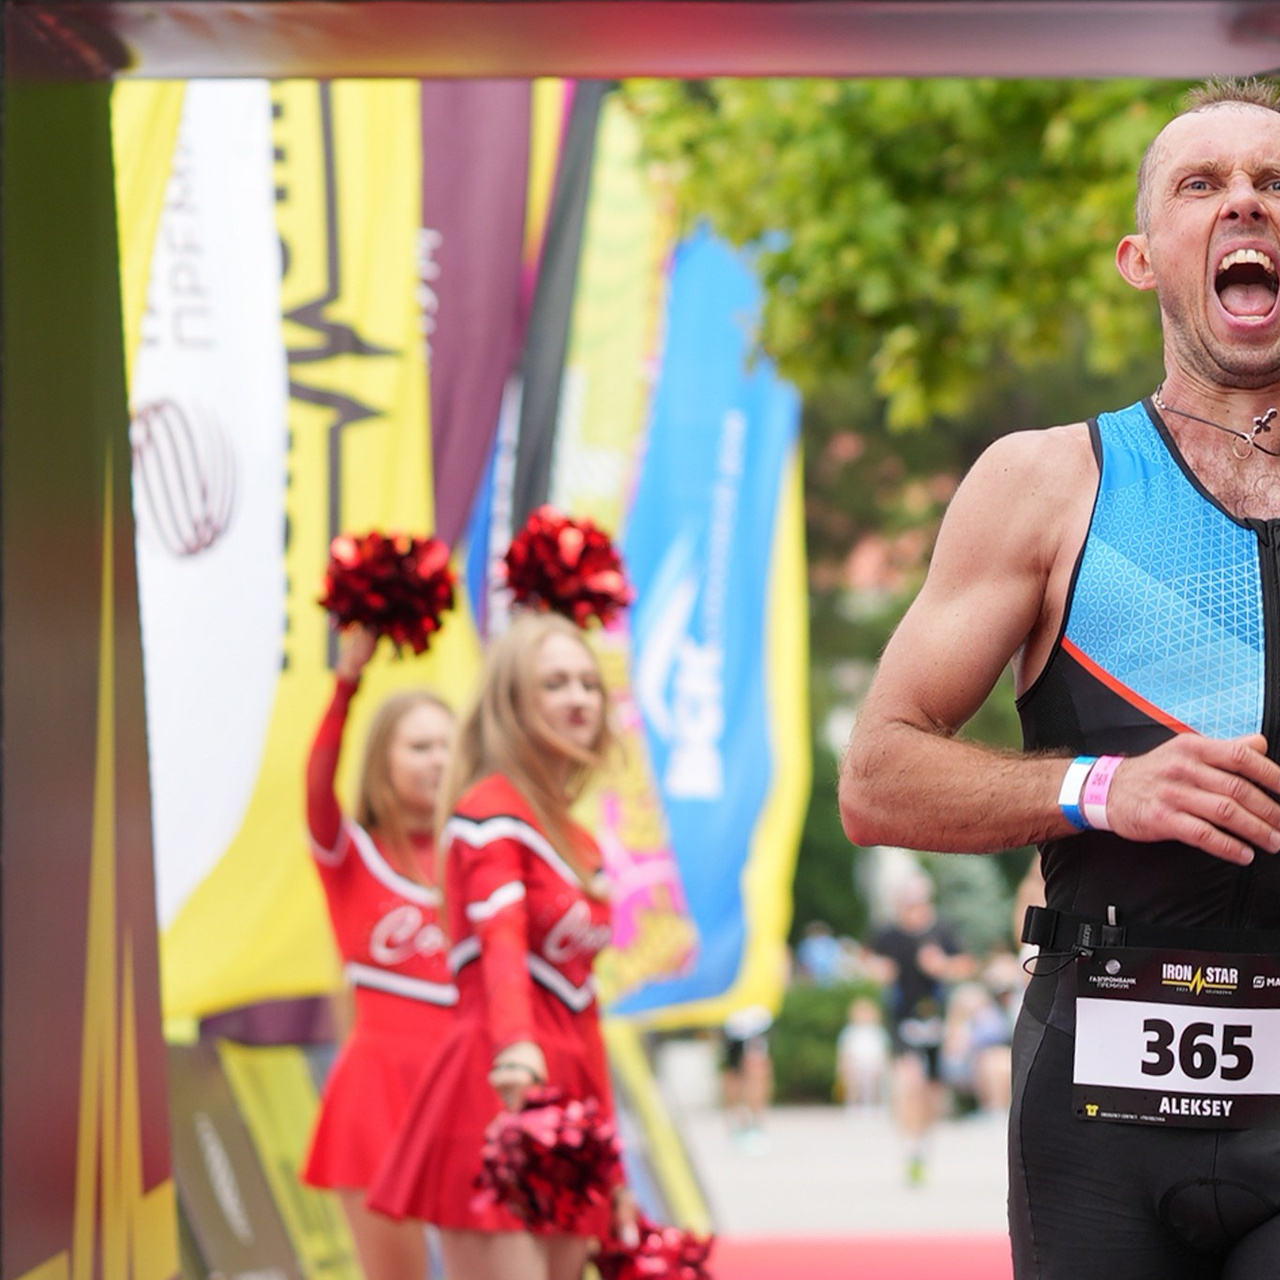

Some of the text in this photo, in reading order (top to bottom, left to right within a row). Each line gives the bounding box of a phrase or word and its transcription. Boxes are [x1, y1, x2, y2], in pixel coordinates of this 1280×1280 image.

[1162, 963, 1239, 984] IRON STAR
[1140, 1018, 1254, 1081] 365
[1159, 1096, 1234, 1118] ALEKSEY
